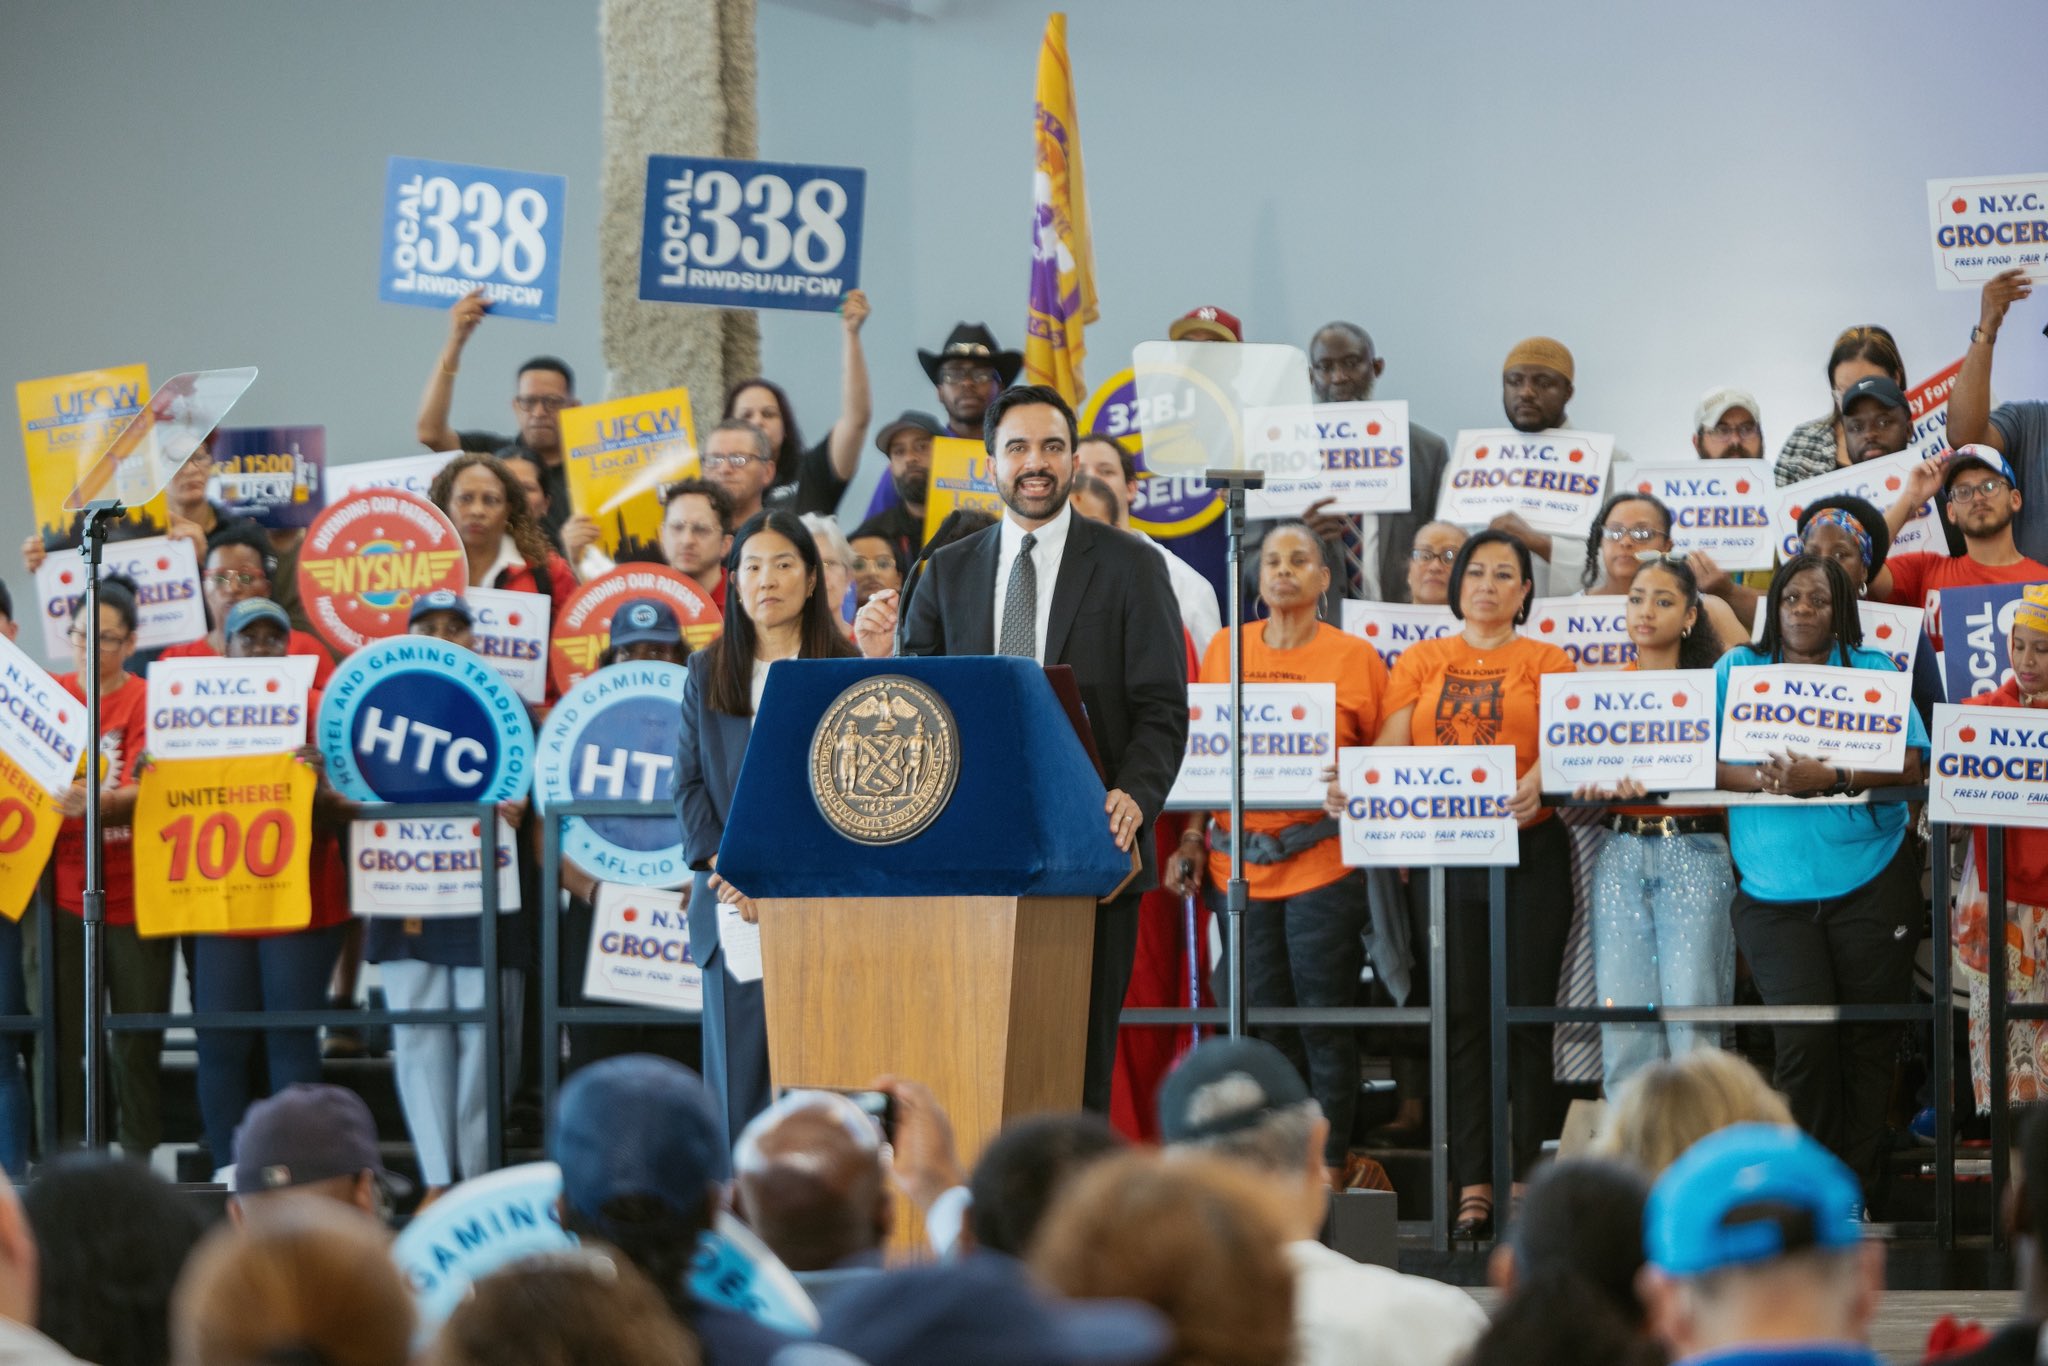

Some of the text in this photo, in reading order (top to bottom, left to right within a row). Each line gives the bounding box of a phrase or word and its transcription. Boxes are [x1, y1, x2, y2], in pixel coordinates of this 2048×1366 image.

[1978, 192, 2045, 214] N.Y.C.
[393, 174, 423, 290] LOCAL
[416, 176, 548, 285] 338
[660, 168, 694, 286] LOCAL
[689, 170, 848, 274] 338
[1954, 252, 2041, 267] FRESH FOOD FAIR
[688, 267, 843, 295] RWDSU/UFCW
[54, 383, 139, 417] UFCW
[1107, 387, 1196, 435] 32BJ
[597, 405, 681, 441] UFCW
[243, 453, 295, 473] 1500
[591, 448, 639, 472] Local
[1500, 444, 1559, 462] N.Y.C.
[1453, 467, 1600, 496] GROCERIES
[1665, 479, 1727, 496] N.Y.C.
[331, 550, 433, 593] NYSNA
[566, 575, 627, 629] DEFENDING
[627, 573, 656, 590] OUR
[369, 646, 457, 671] GAMING
[195, 678, 257, 695] N.Y.C.
[334, 669, 365, 710] AND
[464, 661, 522, 737] TRADES
[1448, 683, 1494, 696] CASA
[1784, 680, 1855, 702] N.Y.C.
[551, 707, 578, 754] AND
[583, 670, 672, 704] GAMING
[1594, 692, 1663, 711] N.Y.C.
[154, 704, 301, 730] GROCERIES
[1731, 702, 1903, 736] GROCERIES
[1546, 719, 1711, 747] GROCERIES
[1745, 731, 1882, 751] FRESH FOOD FAIR PRICES
[327, 717, 354, 786] HOTEL
[358, 706, 488, 788] HTC
[1562, 753, 1693, 767] FRESH FOOD FAIR PRICES
[577, 742, 674, 804] HT
[1278, 766, 1313, 777] PRICES
[1394, 767, 1462, 786] N.Y.C.
[1936, 752, 2048, 782] GROCE
[1347, 794, 1513, 821] GROCERIES
[1953, 788, 1987, 799] FRESH
[1991, 790, 2019, 801] FOOD
[399, 821, 463, 841] N.Y.C.
[1364, 829, 1496, 841] FRESH FOOD FAIR PRICES
[160, 808, 296, 882] 100
[594, 850, 674, 877] AFL-CIO
